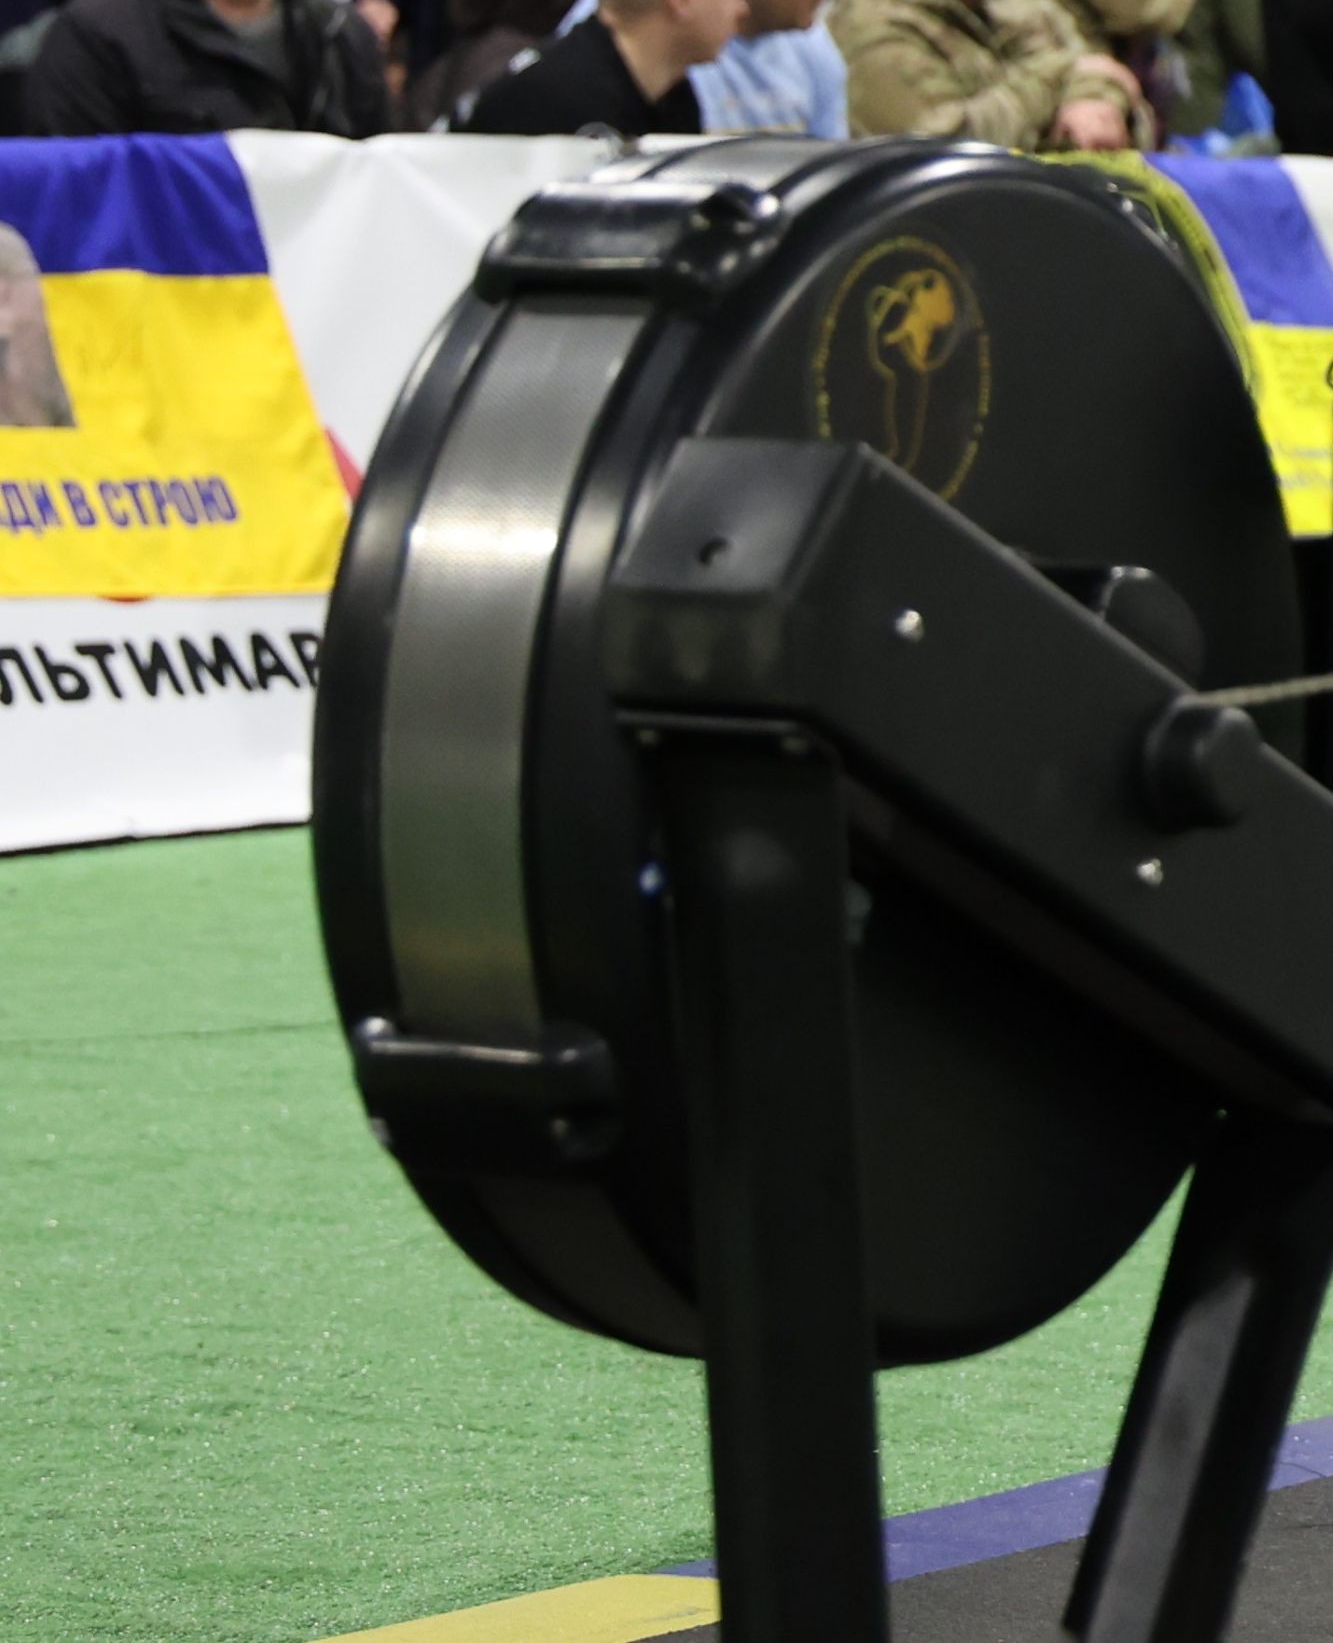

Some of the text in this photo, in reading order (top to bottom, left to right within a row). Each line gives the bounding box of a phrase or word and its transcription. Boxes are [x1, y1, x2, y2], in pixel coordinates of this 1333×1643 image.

[0, 476, 238, 535] ДИ В СТРОЮ
